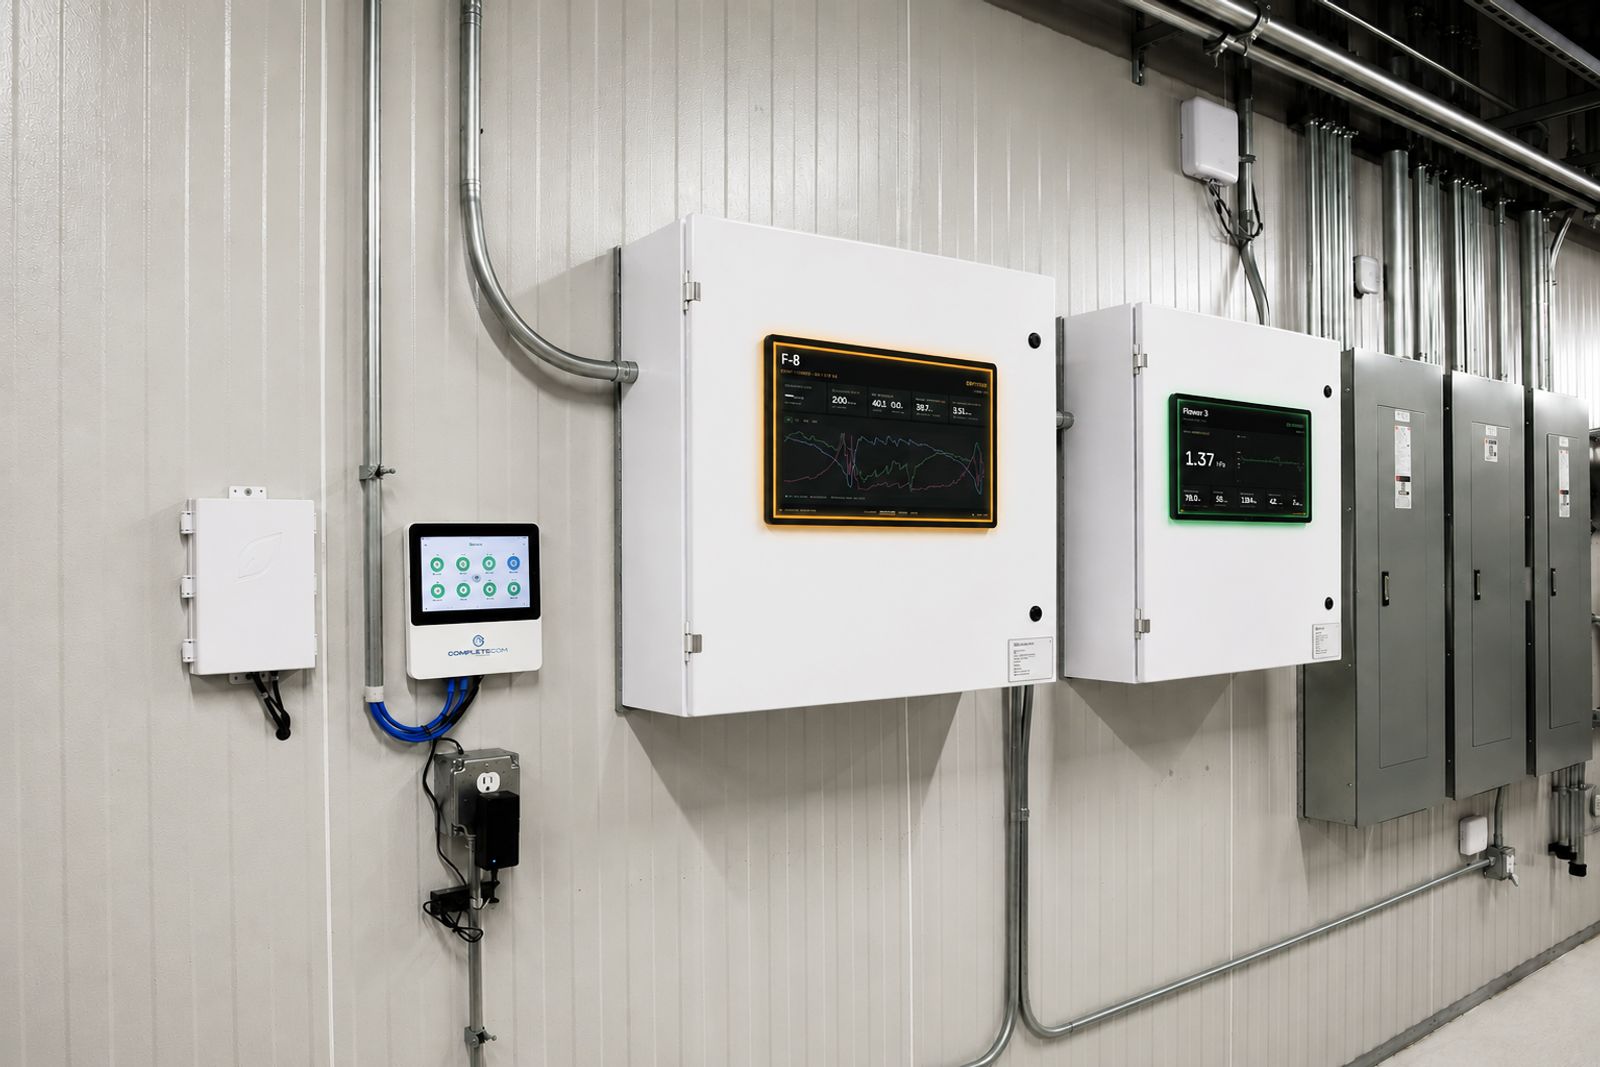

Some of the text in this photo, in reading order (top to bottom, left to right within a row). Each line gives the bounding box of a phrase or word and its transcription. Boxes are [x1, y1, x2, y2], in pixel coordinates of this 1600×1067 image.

[781, 352, 800, 366] F-8
[1203, 409, 1209, 417] 3
[1185, 450, 1214, 467] 1.37
